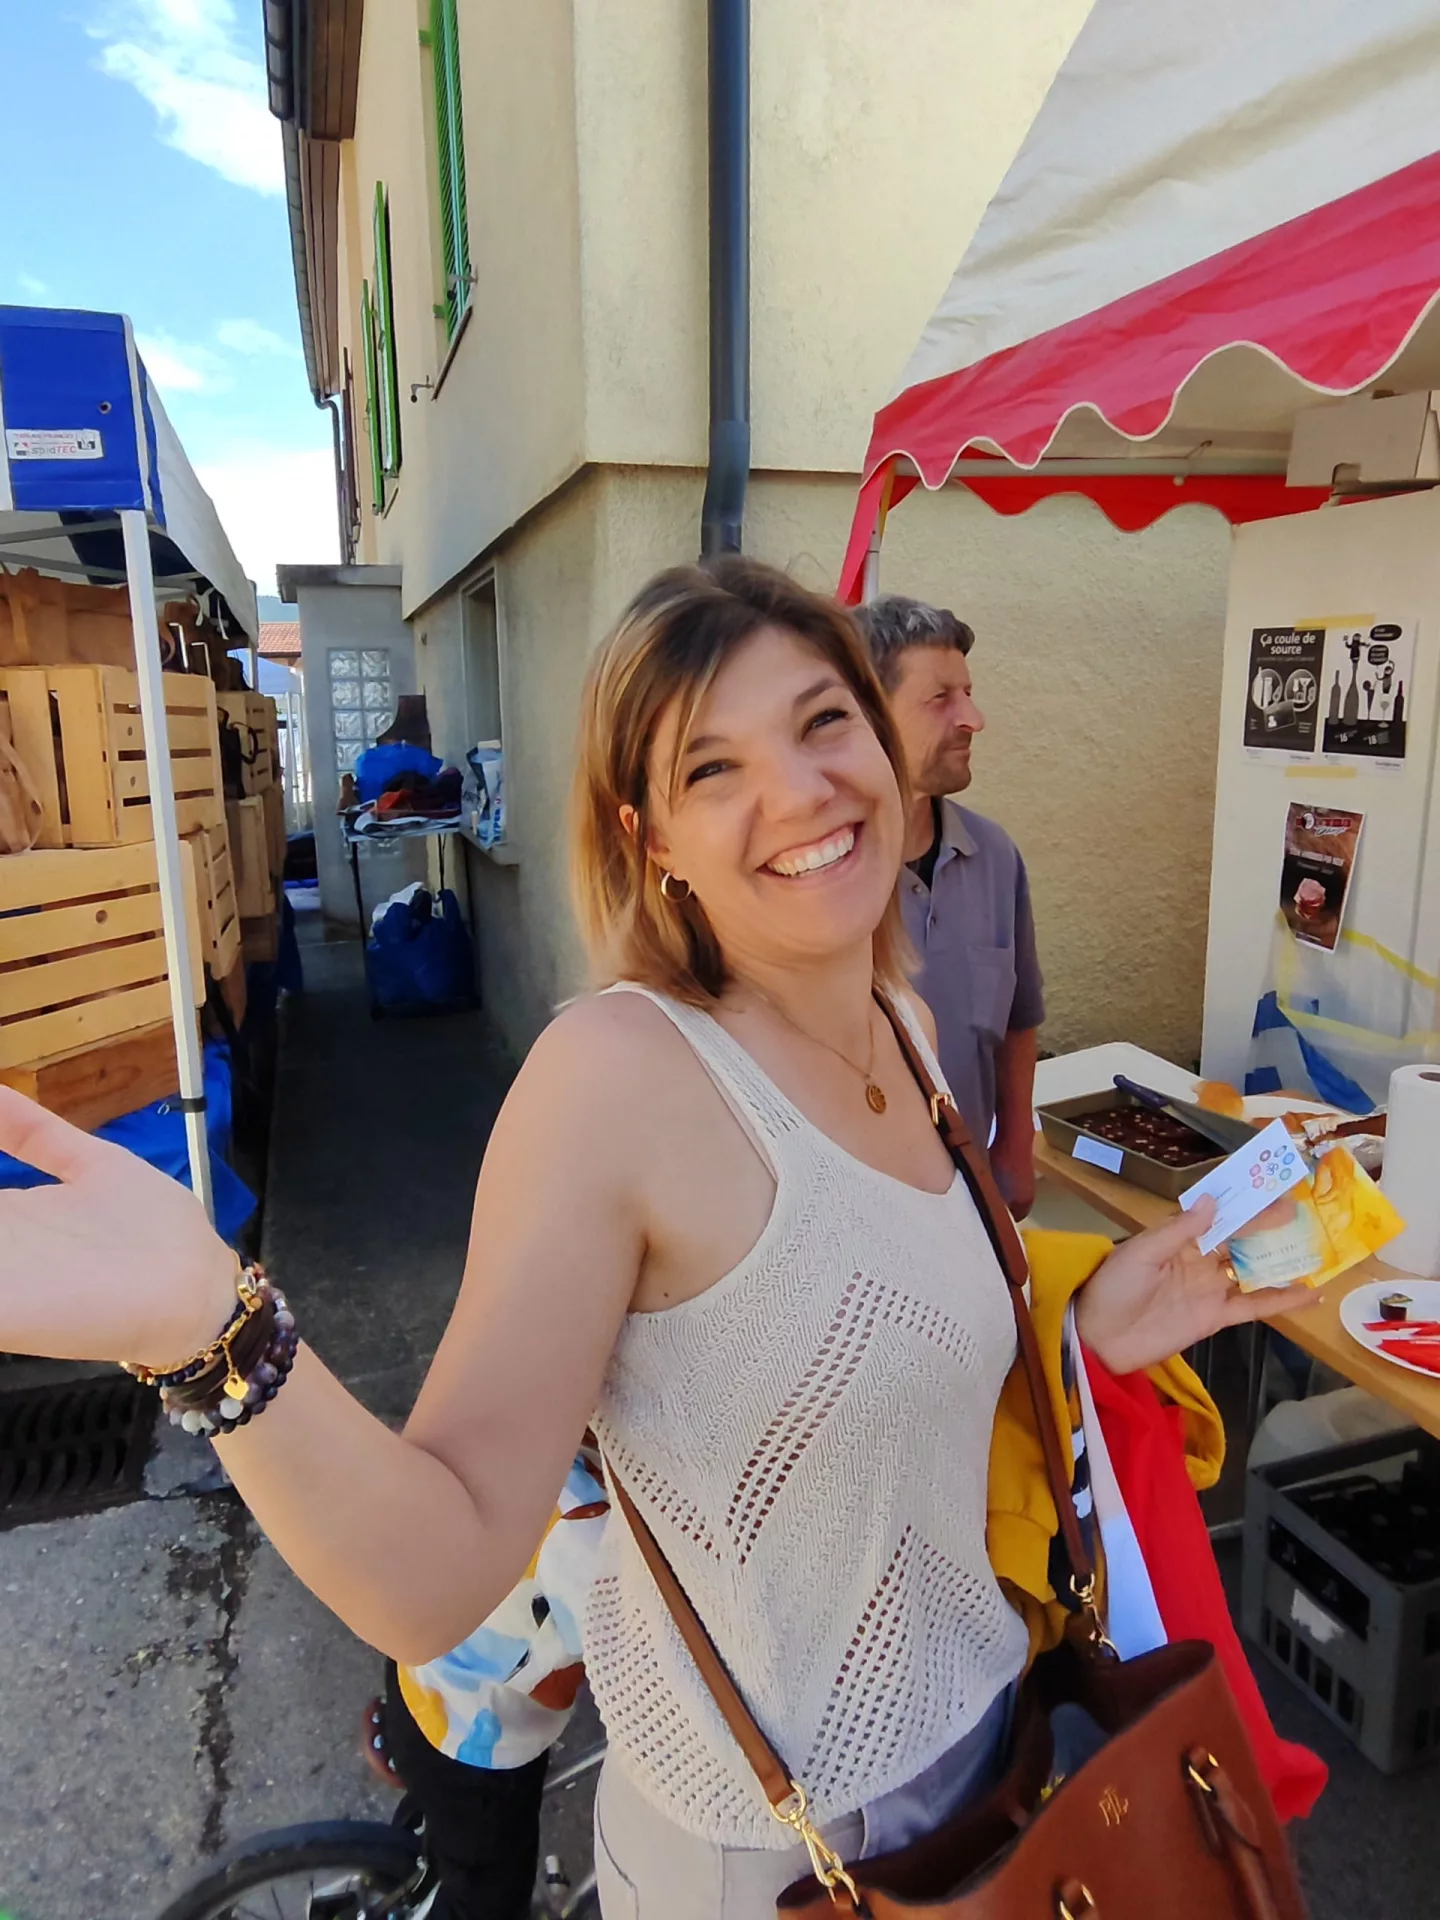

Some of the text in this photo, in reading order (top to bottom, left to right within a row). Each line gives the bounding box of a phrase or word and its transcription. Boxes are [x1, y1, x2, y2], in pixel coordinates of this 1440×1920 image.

[1260, 631, 1316, 647] Ça coule de
[1270, 645, 1302, 655] source
[1340, 733, 1348, 743] 16
[1368, 735, 1377, 745] 18
